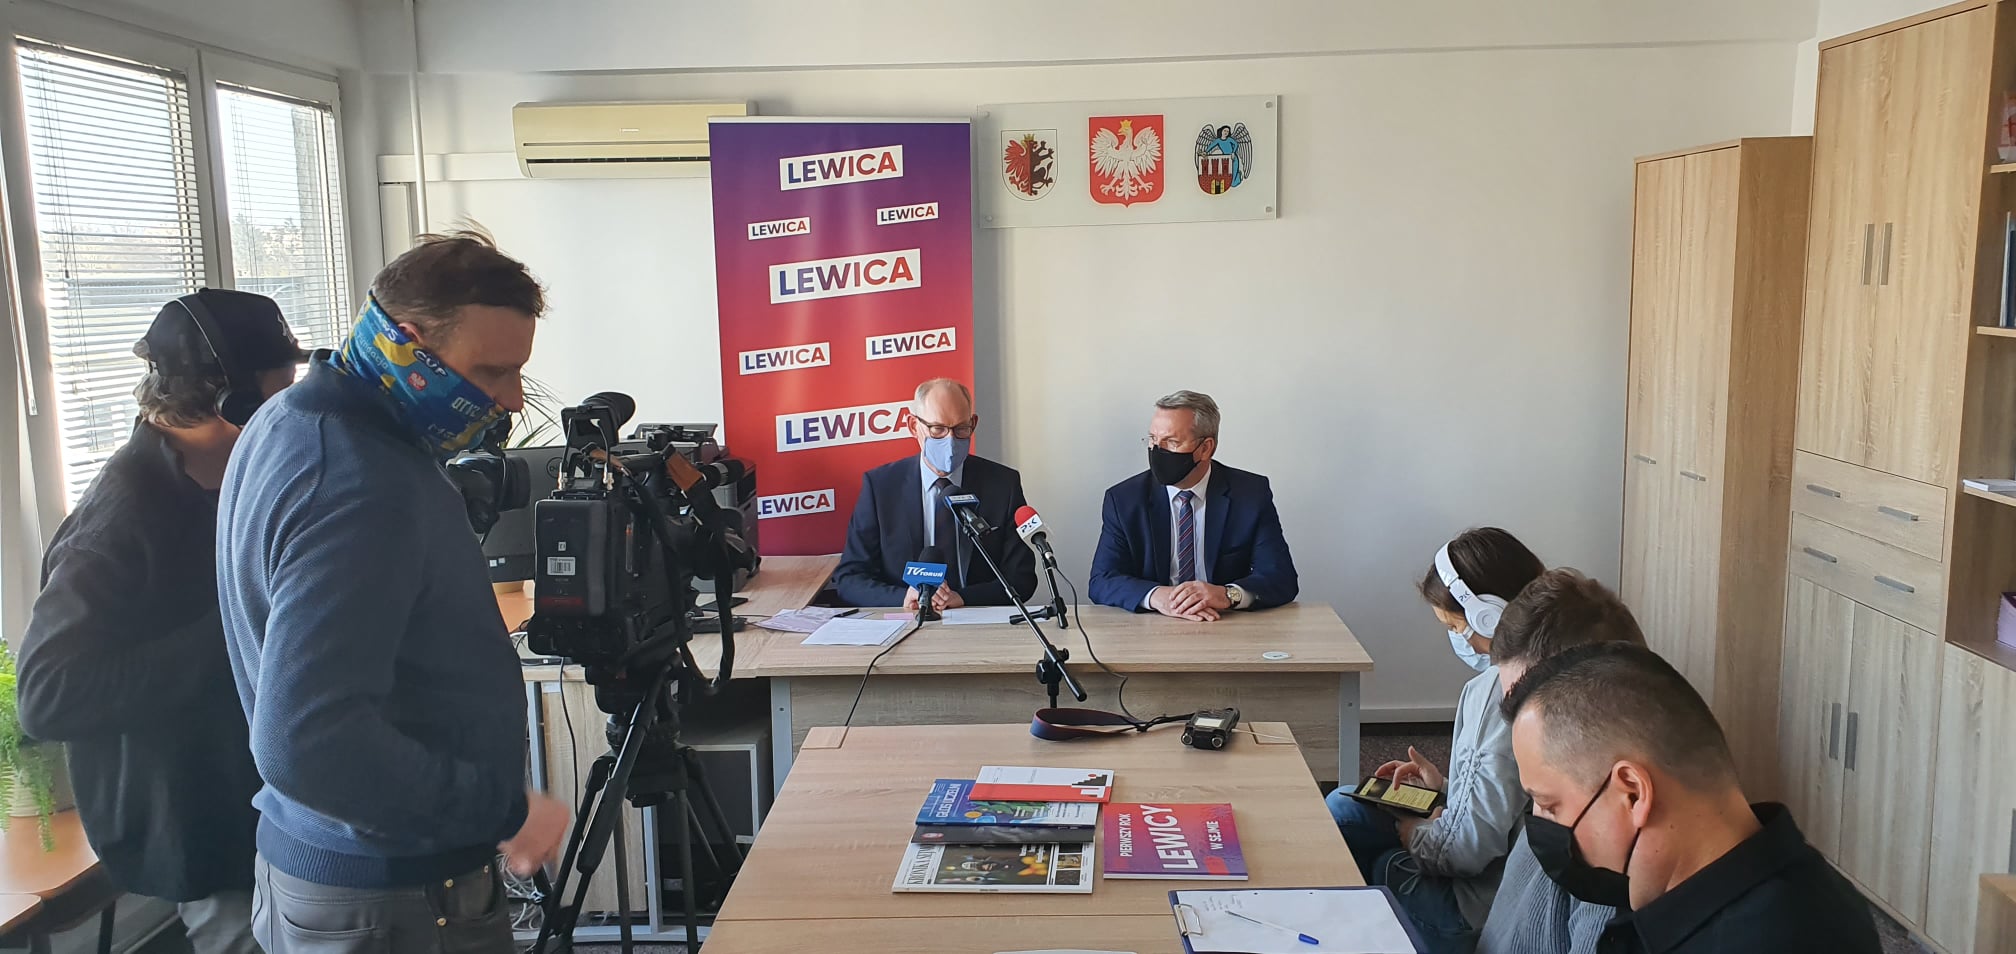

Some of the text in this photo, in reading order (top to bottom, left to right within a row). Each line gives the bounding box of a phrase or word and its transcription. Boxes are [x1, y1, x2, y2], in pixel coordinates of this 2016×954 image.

[787, 151, 897, 184] LEWICA
[880, 205, 935, 222] LEWICA
[752, 220, 806, 237] LEWICA
[779, 257, 913, 297] LEWICA
[871, 332, 952, 355] LEWICA
[415, 350, 447, 376] CUP
[744, 346, 826, 371] LEWICA
[786, 406, 912, 445] LEWICA
[1119, 813, 1132, 857] PIERWSZY ROK
[1140, 804, 1199, 869] LEWICY
[1206, 821, 1223, 842] SEJMIE
